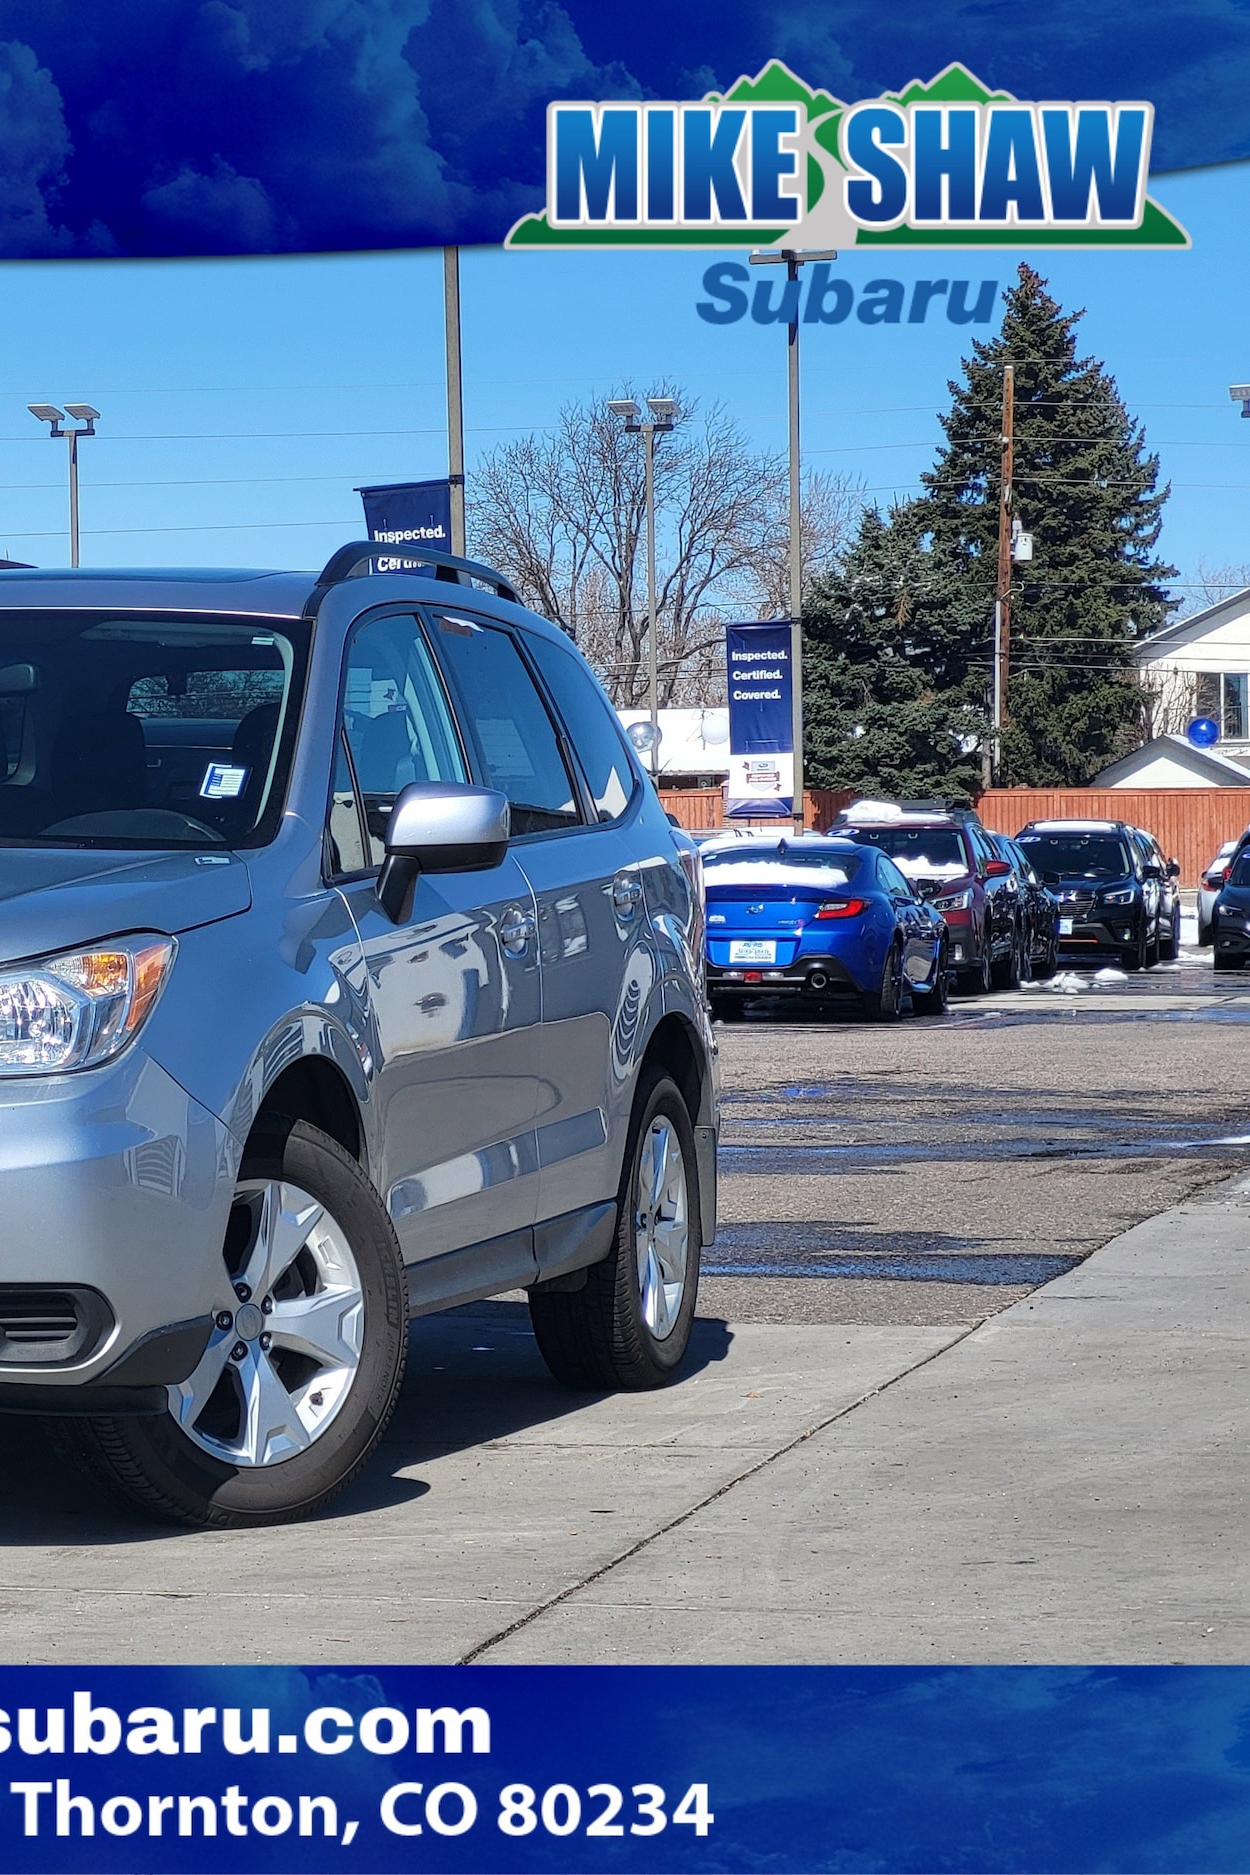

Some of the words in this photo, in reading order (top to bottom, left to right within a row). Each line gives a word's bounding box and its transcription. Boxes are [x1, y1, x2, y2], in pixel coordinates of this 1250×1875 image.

[373, 524, 447, 545] Inspected.
[731, 650, 788, 662] Inspected.
[732, 669, 783, 681] Certified.
[733, 689, 782, 700] Covered.
